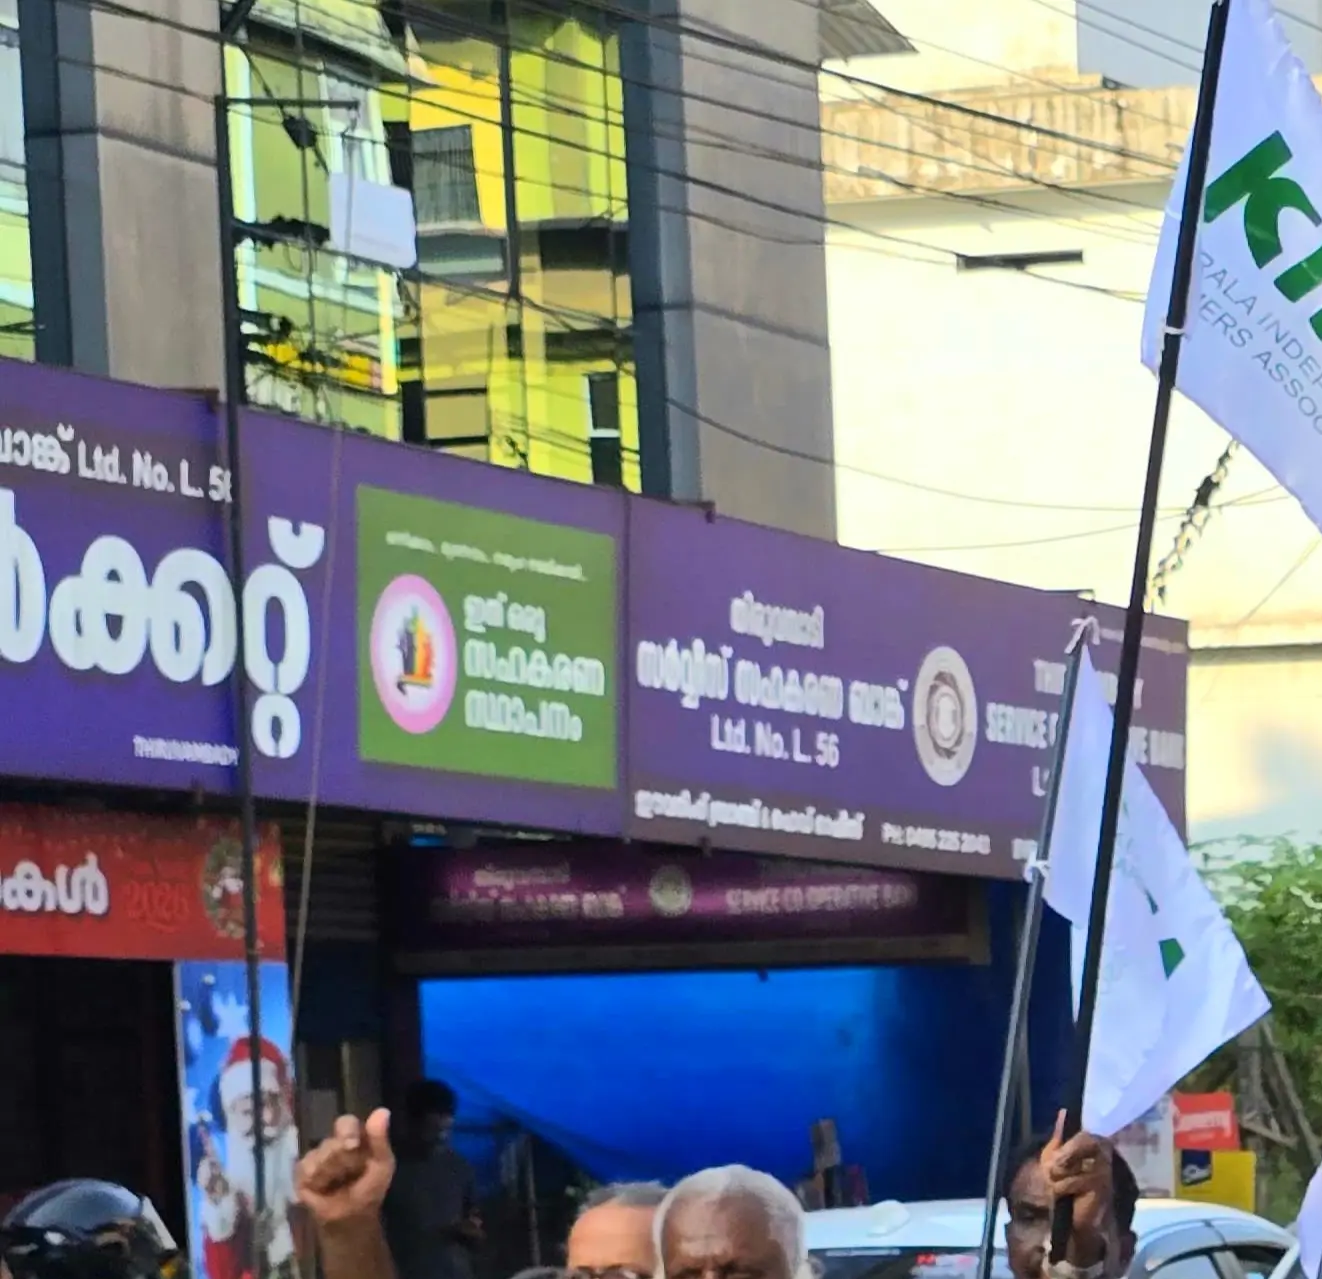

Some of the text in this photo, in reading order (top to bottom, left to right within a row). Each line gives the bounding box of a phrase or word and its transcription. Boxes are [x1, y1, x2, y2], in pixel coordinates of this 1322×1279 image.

[78, 439, 127, 484] Ltd.
[132, 449, 175, 493] No.
[710, 713, 752, 754] Ltd.
[815, 731, 840, 768] 56
